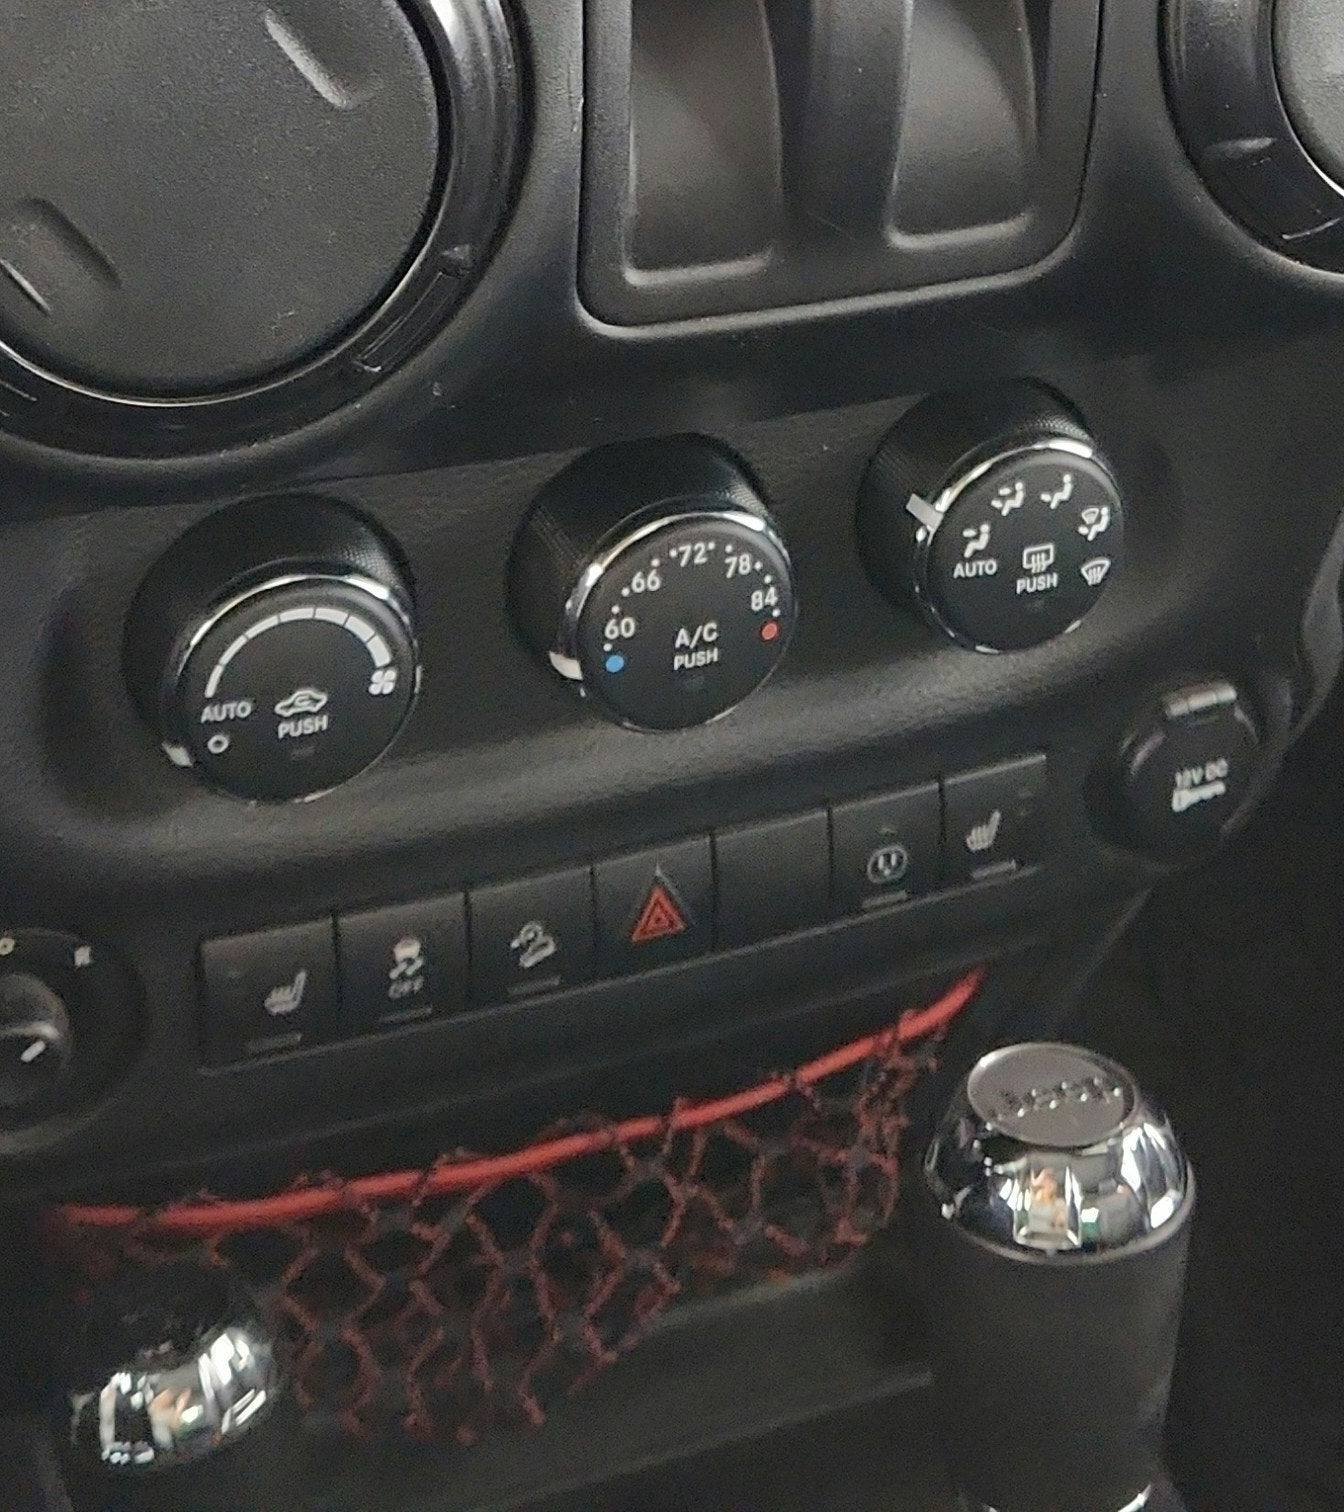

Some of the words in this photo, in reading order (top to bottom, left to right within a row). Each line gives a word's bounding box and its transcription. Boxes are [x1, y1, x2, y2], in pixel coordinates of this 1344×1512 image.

[678, 542, 708, 568] 72
[724, 553, 752, 579] 78
[953, 559, 998, 579] AUTO
[631, 569, 662, 594] 66
[1016, 572, 1059, 595] PUSH
[750, 585, 778, 612] 84
[604, 616, 636, 640] 60
[674, 622, 719, 649] A/C
[673, 647, 719, 671] PUSH
[201, 700, 252, 724] AUTO
[278, 715, 329, 739] PUSH
